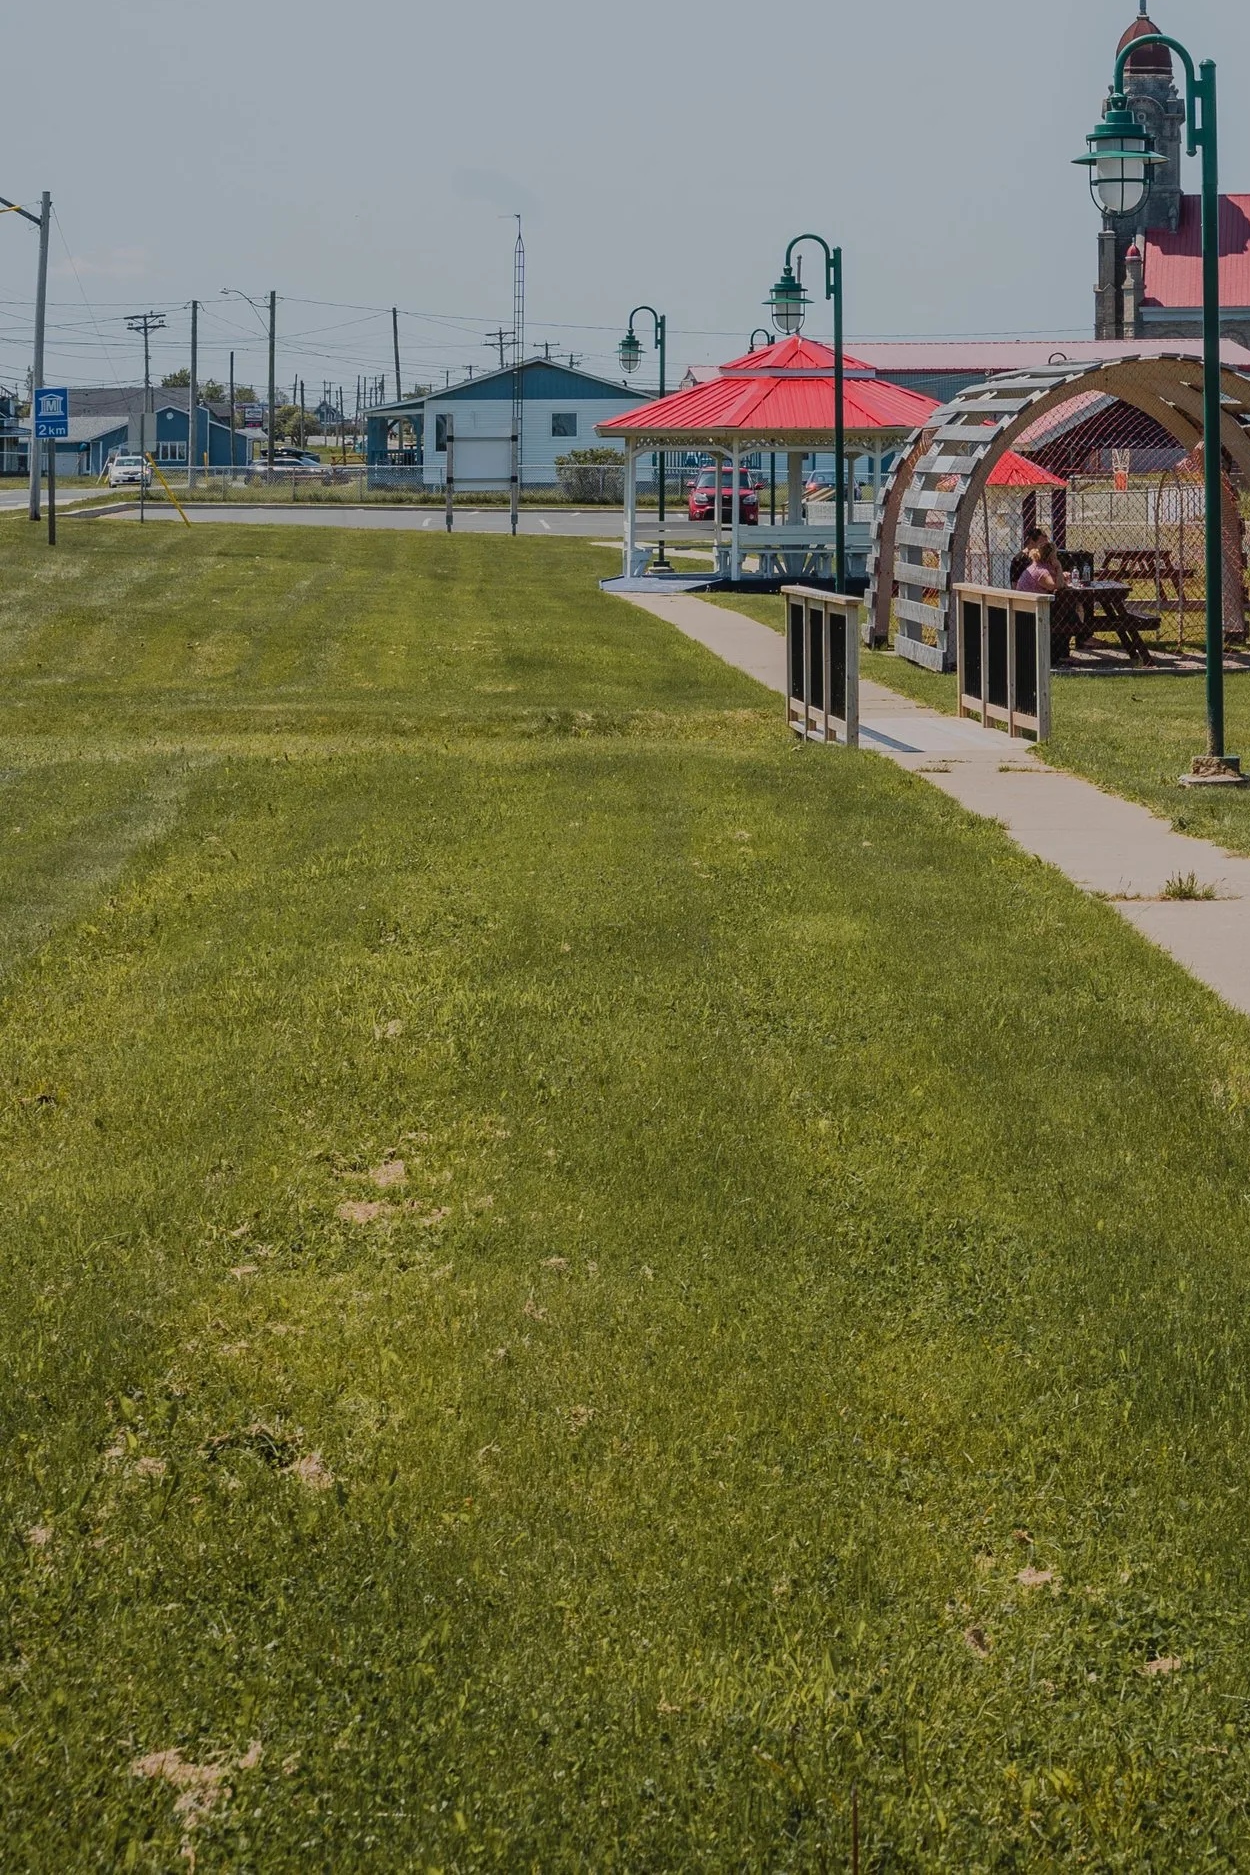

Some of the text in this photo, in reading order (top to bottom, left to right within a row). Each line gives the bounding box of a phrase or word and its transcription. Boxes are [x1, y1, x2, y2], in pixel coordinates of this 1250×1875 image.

[46, 399, 57, 412] M
[38, 424, 66, 436] 2 km
